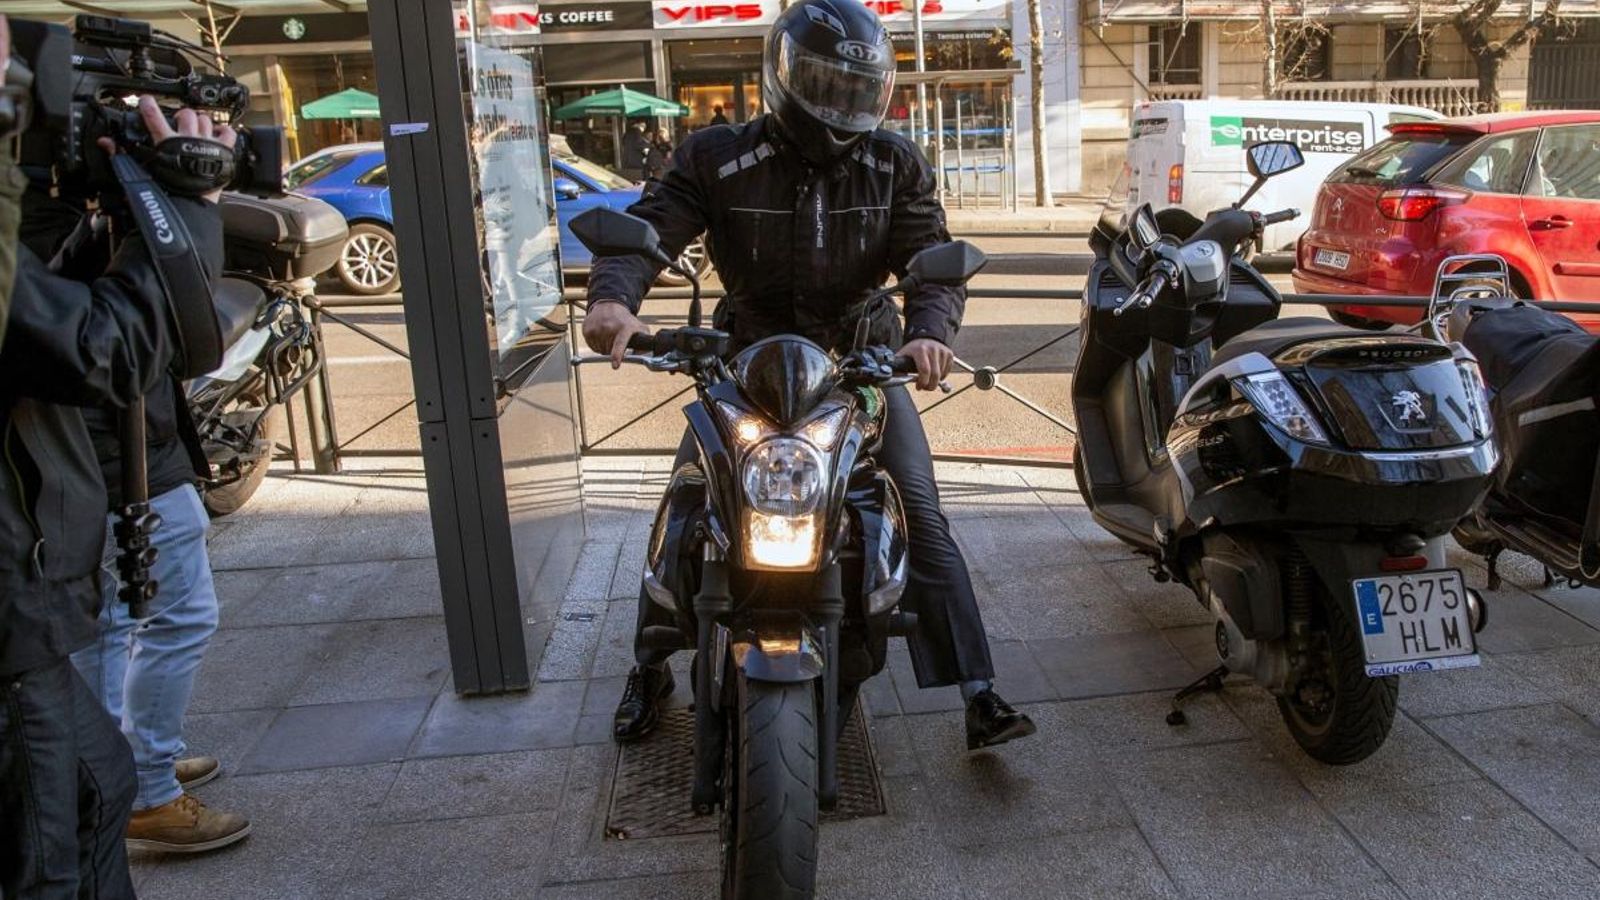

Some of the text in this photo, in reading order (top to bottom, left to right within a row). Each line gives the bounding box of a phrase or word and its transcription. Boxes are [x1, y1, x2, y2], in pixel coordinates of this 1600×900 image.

[559, 10, 614, 23] COFFEE
[660, 4, 762, 20] VIPS
[1221, 124, 1363, 149] enterprise
[181, 142, 221, 156] Canon
[1310, 143, 1363, 152] rent-a-car
[140, 191, 174, 244] Canon
[1359, 349, 1429, 358] PEUGEOT
[1378, 577, 1459, 616] 2675
[1366, 613, 1377, 625] E
[1400, 616, 1462, 654] HLM
[1368, 664, 1416, 676] GALICIA
